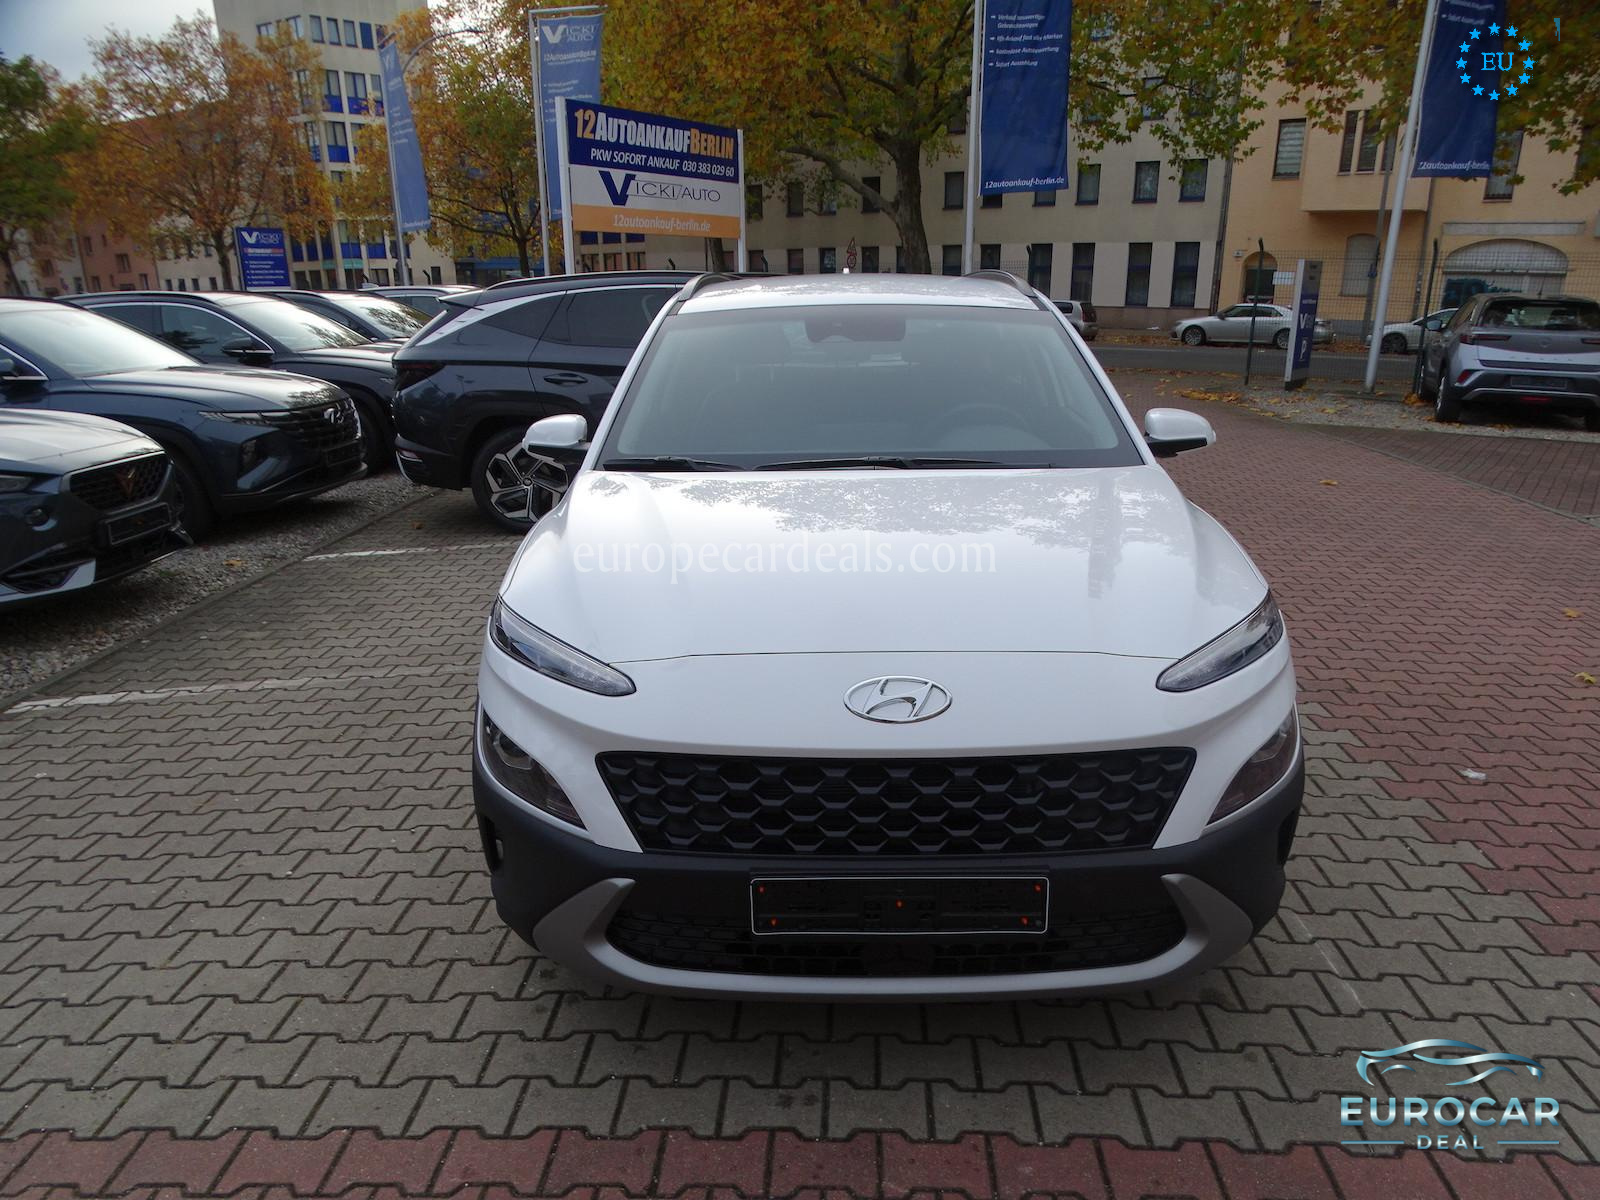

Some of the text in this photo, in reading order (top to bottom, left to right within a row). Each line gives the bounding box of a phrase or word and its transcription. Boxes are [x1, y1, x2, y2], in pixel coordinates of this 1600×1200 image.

[591, 148, 735, 177] PKW SOFORT ANKAUF 030 383 029 60
[613, 213, 711, 233] 12autoankauf-berlin.de
